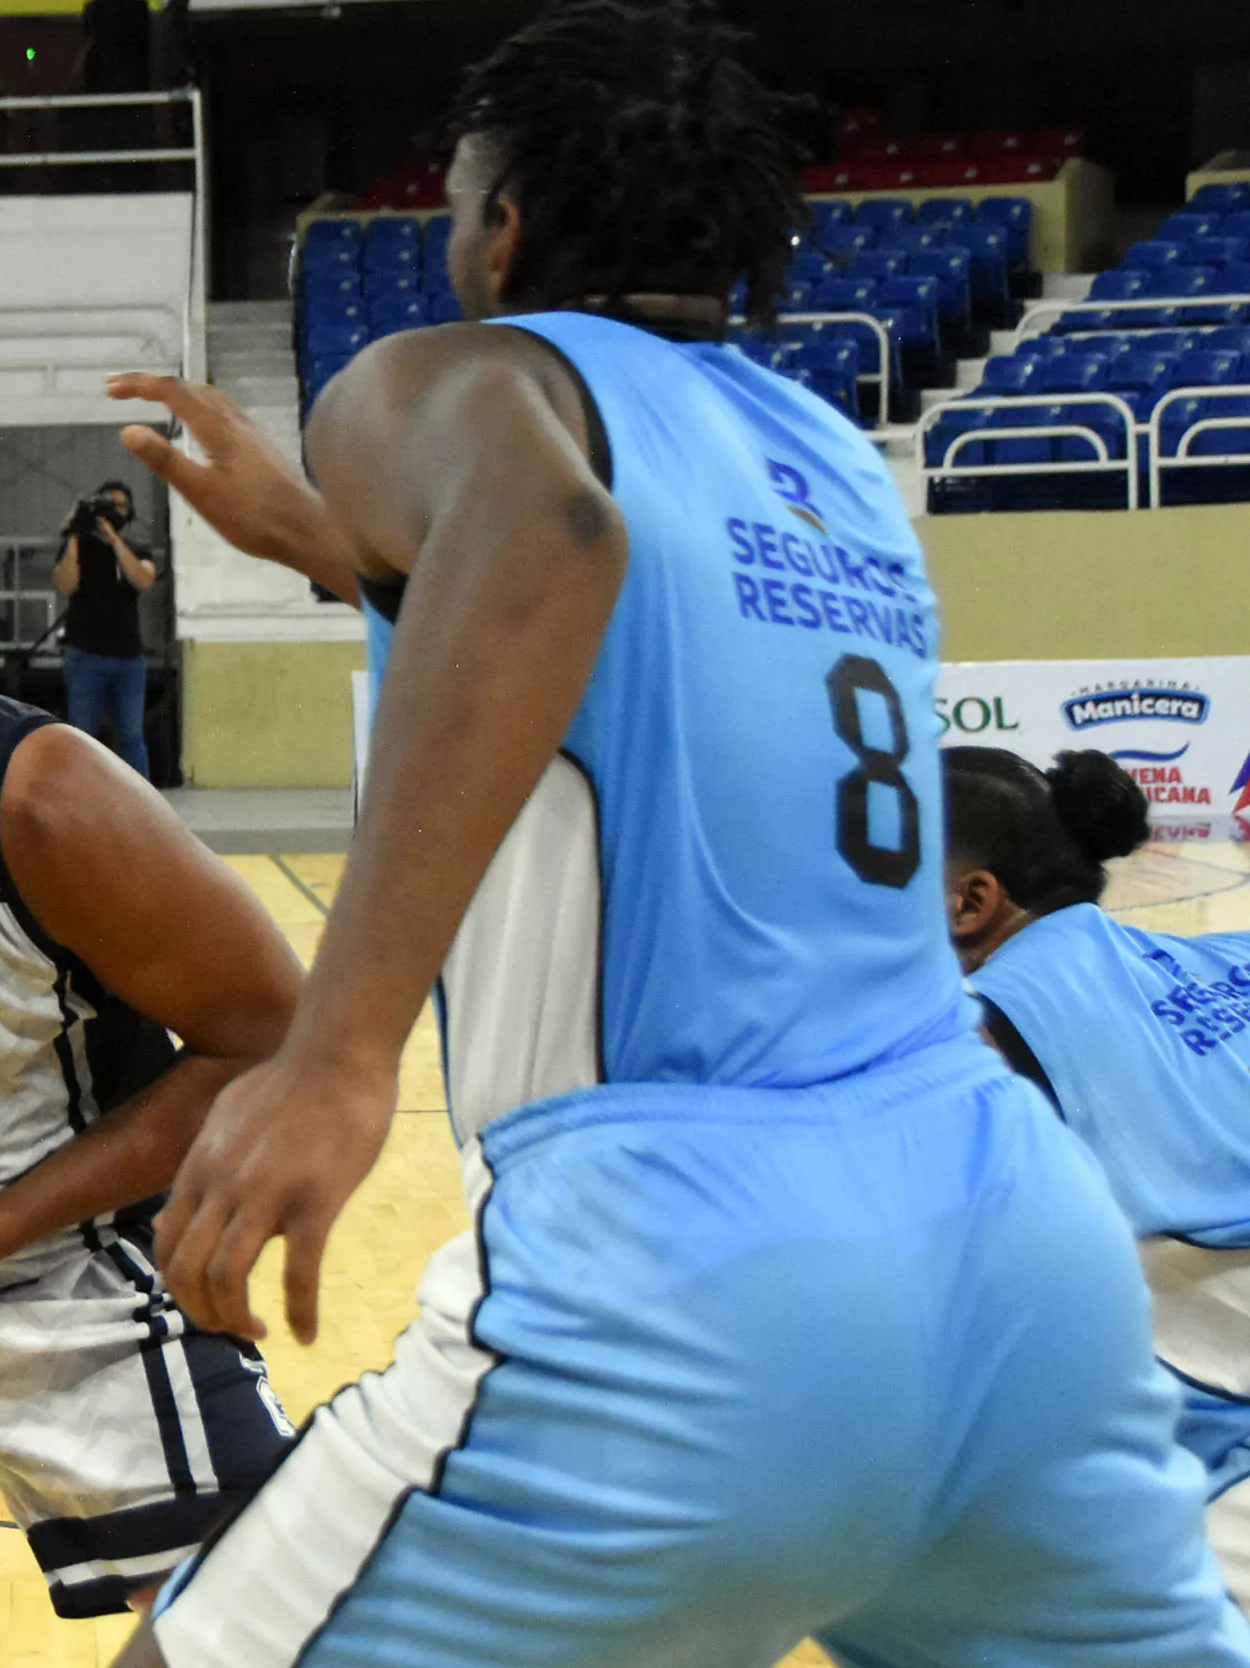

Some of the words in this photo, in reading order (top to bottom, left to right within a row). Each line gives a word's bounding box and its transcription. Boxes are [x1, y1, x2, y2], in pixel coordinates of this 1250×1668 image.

[731, 571, 928, 659] RESERVAS
[1071, 692, 1199, 724] Manicera
[825, 653, 920, 890] 8
